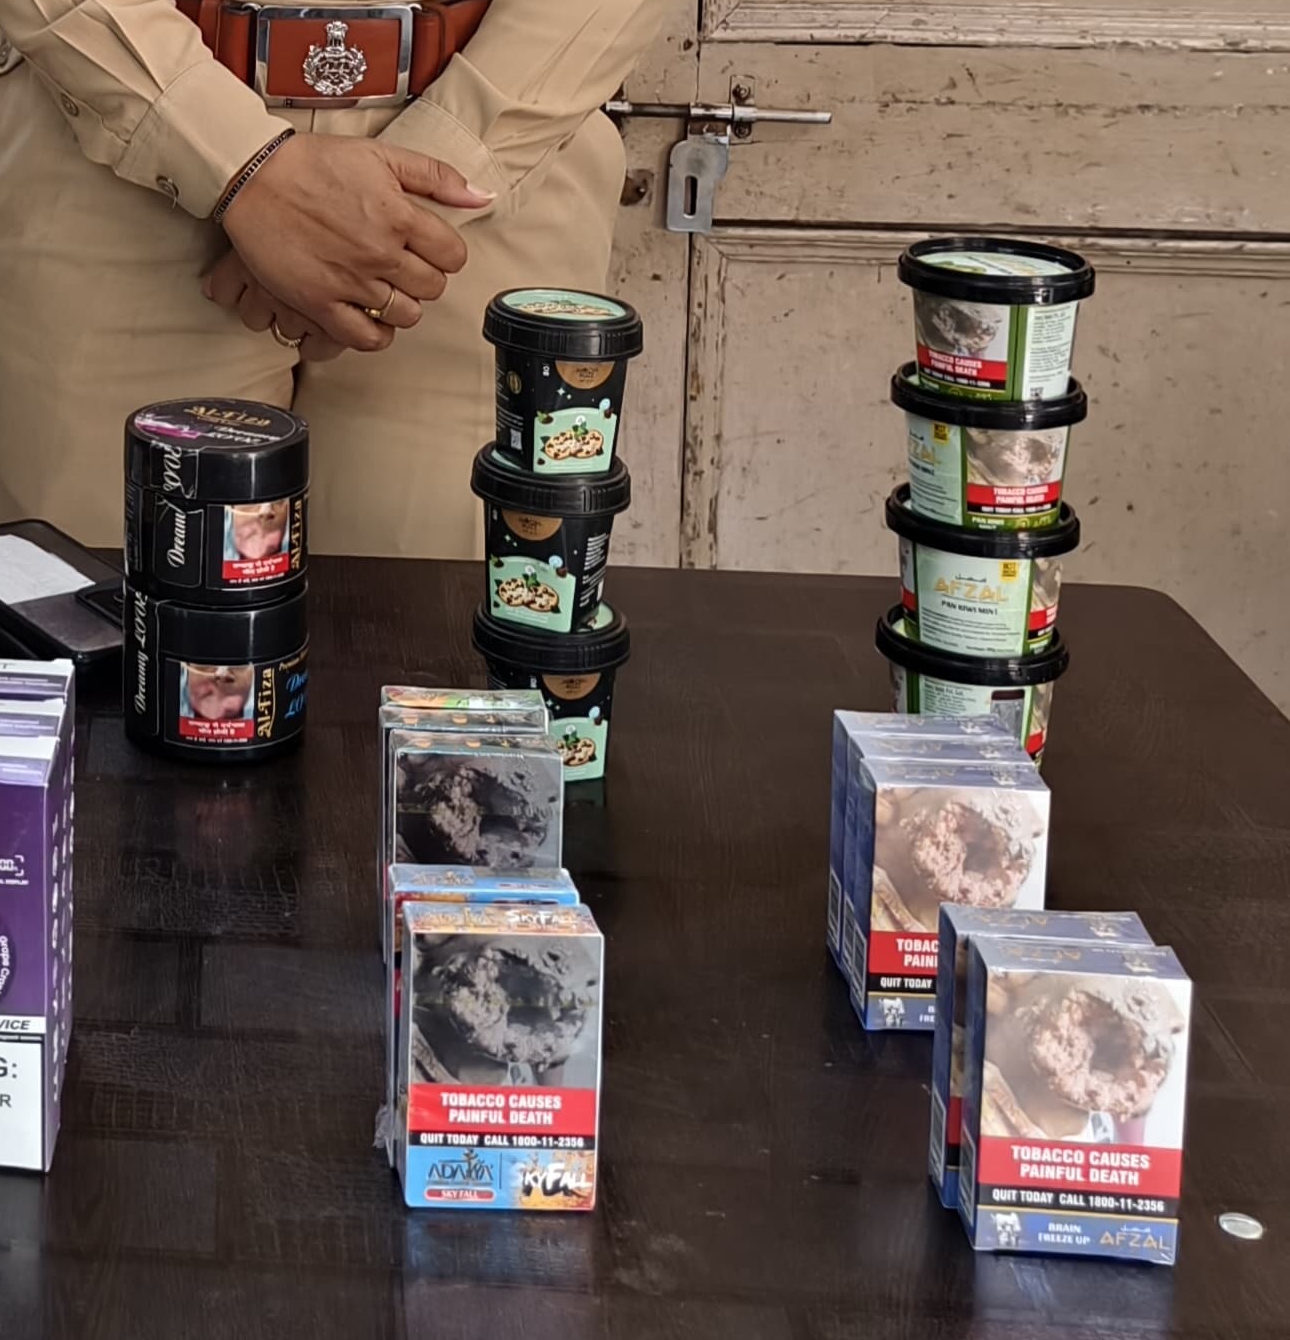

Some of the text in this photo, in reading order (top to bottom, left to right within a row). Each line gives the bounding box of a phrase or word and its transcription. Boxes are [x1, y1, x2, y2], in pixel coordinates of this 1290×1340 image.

[934, 577, 1008, 602] AFZAL
[257, 667, 275, 738] Al-Fiza
[896, 938, 939, 953] TOBAC
[903, 954, 938, 968] PAIN
[880, 976, 933, 989] QUIT TODAY
[440, 1091, 563, 1110] TOBACCO CAUSES
[448, 1108, 554, 1126] PAINFUL DEATH
[420, 1132, 585, 1148] QUIT TODAY CALL 1800-11-2356
[1011, 1144, 1151, 1170] TOBACCO CAUSES
[1020, 1162, 1139, 1186] PAINFUL DEATH
[992, 1188, 1165, 1212] QUIT TODAY CALL 1800-11-2356
[1047, 1222, 1082, 1234] BRAIN
[1037, 1232, 1091, 1246] FREEZE UP
[1099, 1230, 1172, 1252] AFZAL
